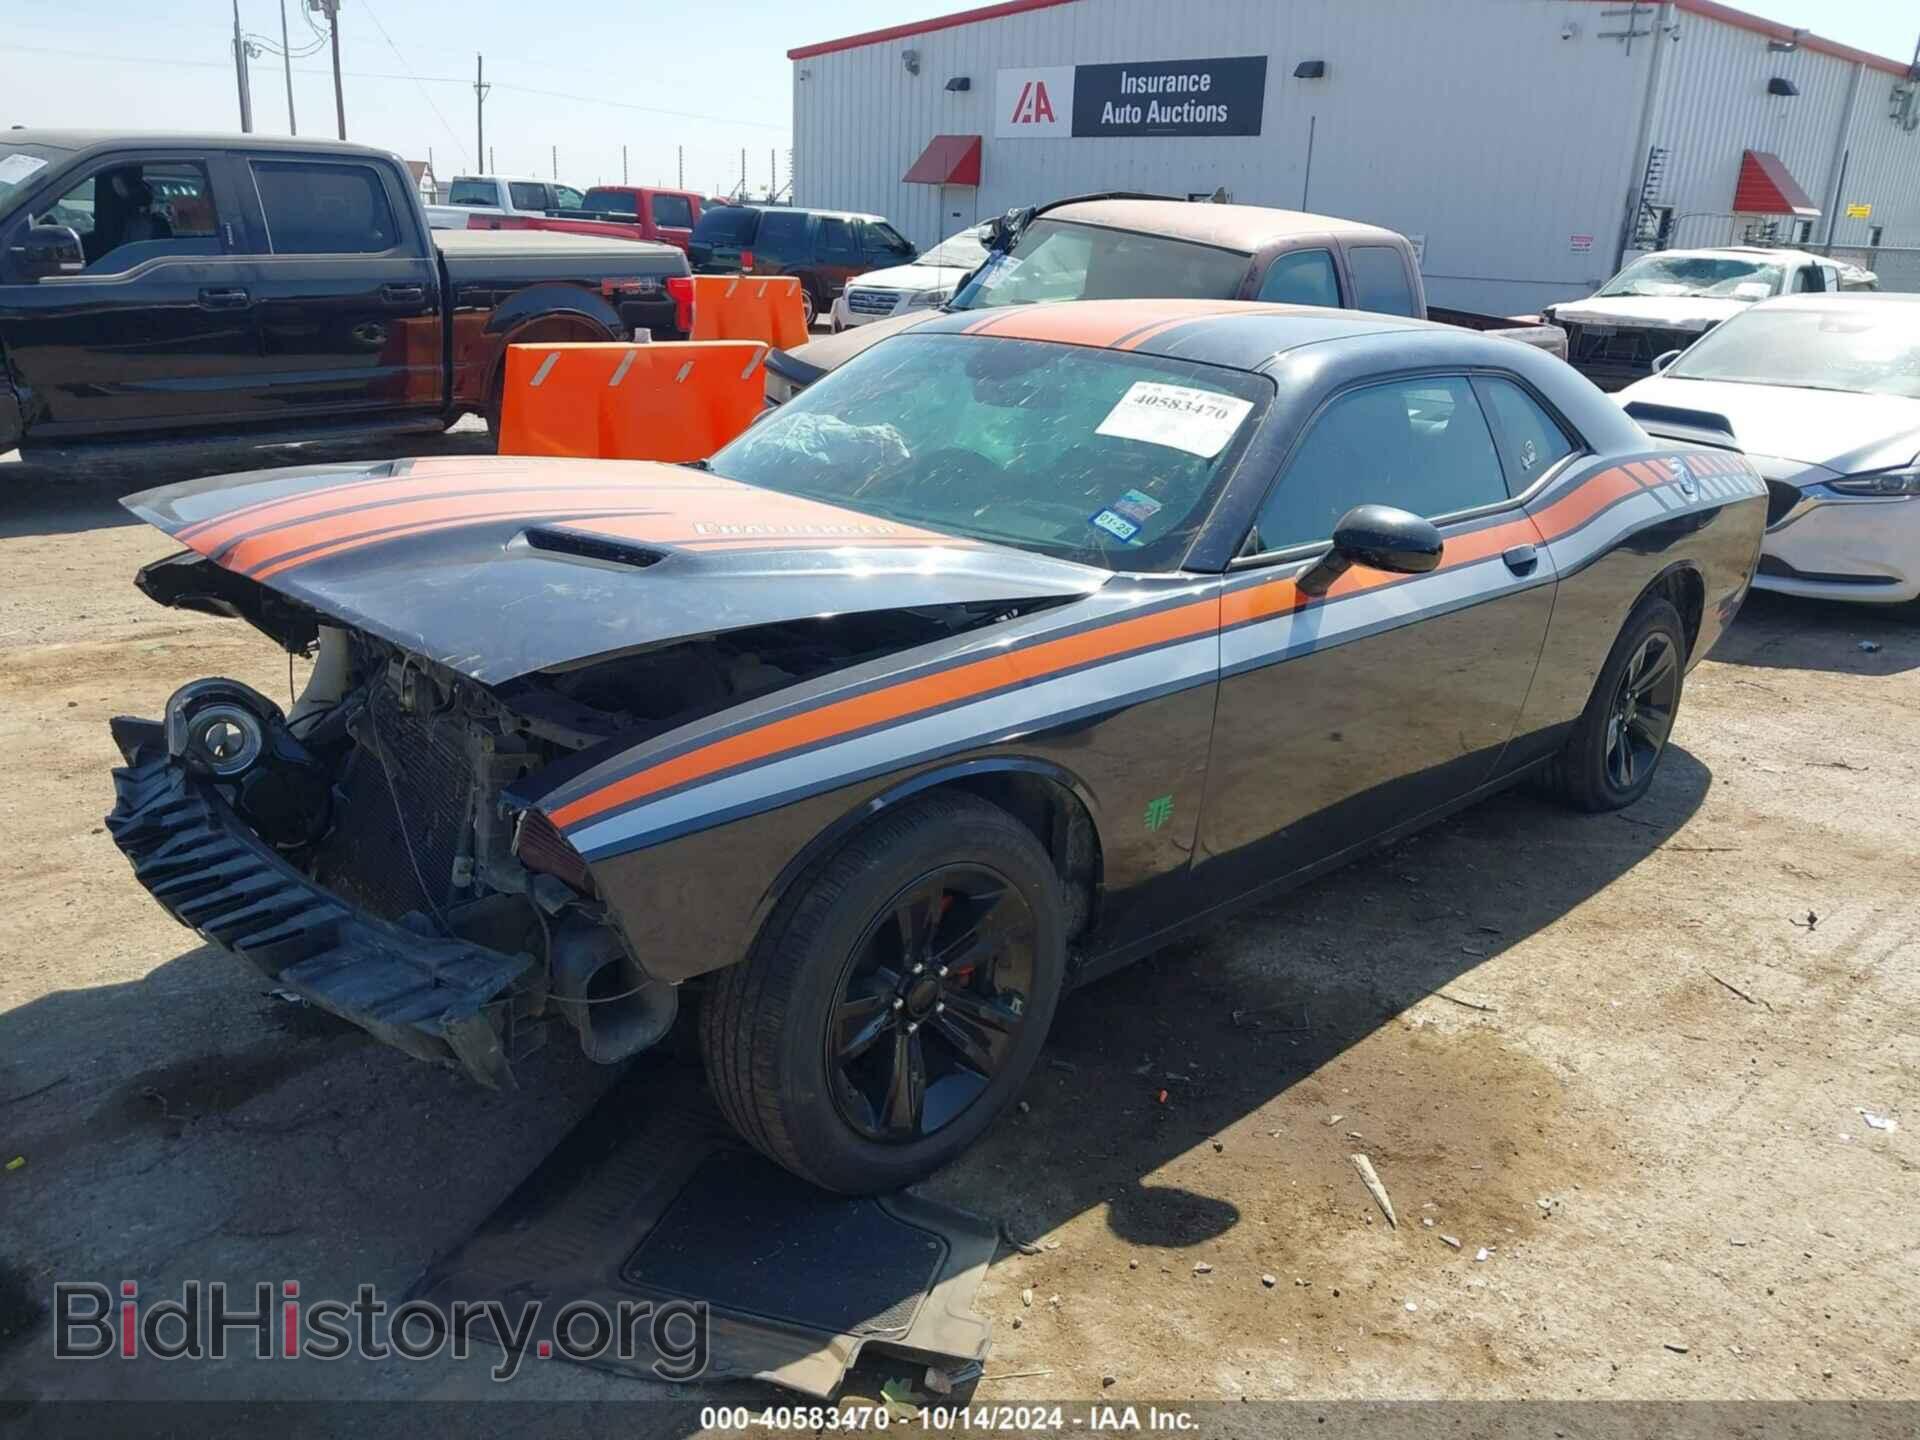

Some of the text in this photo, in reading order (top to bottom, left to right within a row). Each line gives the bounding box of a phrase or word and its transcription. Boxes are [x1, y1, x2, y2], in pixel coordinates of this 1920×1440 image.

[1121, 71, 1211, 93] Insurance
[1101, 99, 1227, 124] Auto Auctions
[1133, 394, 1229, 420] 40583470
